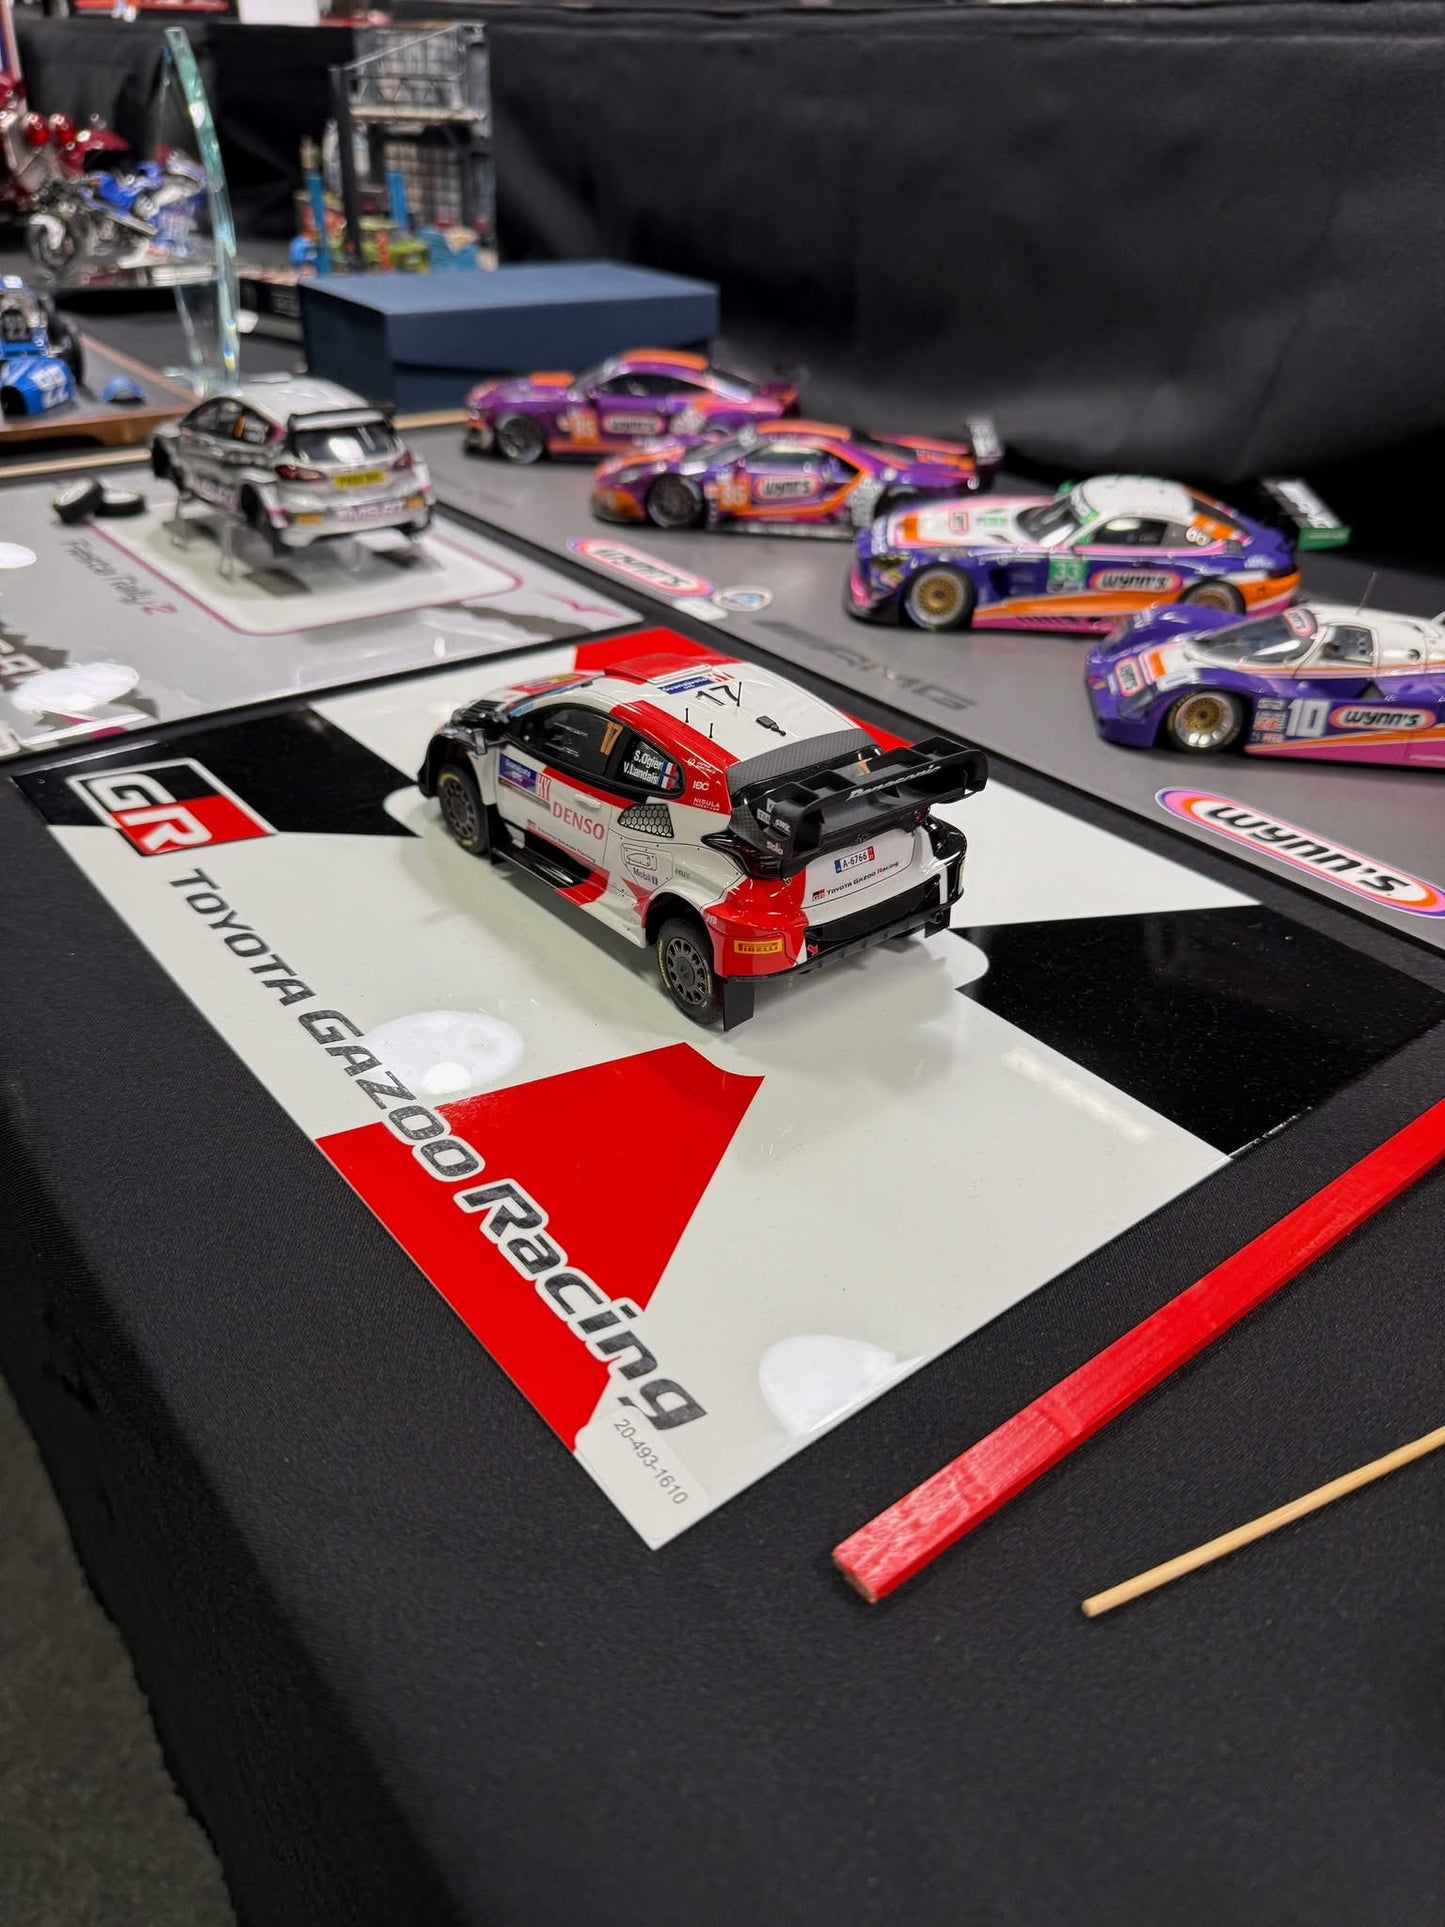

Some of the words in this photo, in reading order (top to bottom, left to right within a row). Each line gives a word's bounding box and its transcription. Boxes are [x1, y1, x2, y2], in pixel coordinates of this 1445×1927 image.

[1055, 563, 1080, 581] 33
[695, 685, 739, 706] 17
[1286, 698, 1331, 737] 10
[1344, 710, 1420, 727] wynn's
[600, 722, 623, 756] 17
[846, 764, 942, 802] Panasonic
[88, 772, 213, 851] GR
[552, 801, 605, 840] DENSO
[842, 851, 868, 869] A-6766
[877, 861, 899, 875] Racing
[1207, 806, 1411, 892] wynn's
[169, 867, 317, 1006] TOYOTA
[298, 1009, 479, 1177] GAZOO
[462, 1183, 707, 1431] Racing
[613, 1418, 688, 1505] 20-493-1610
